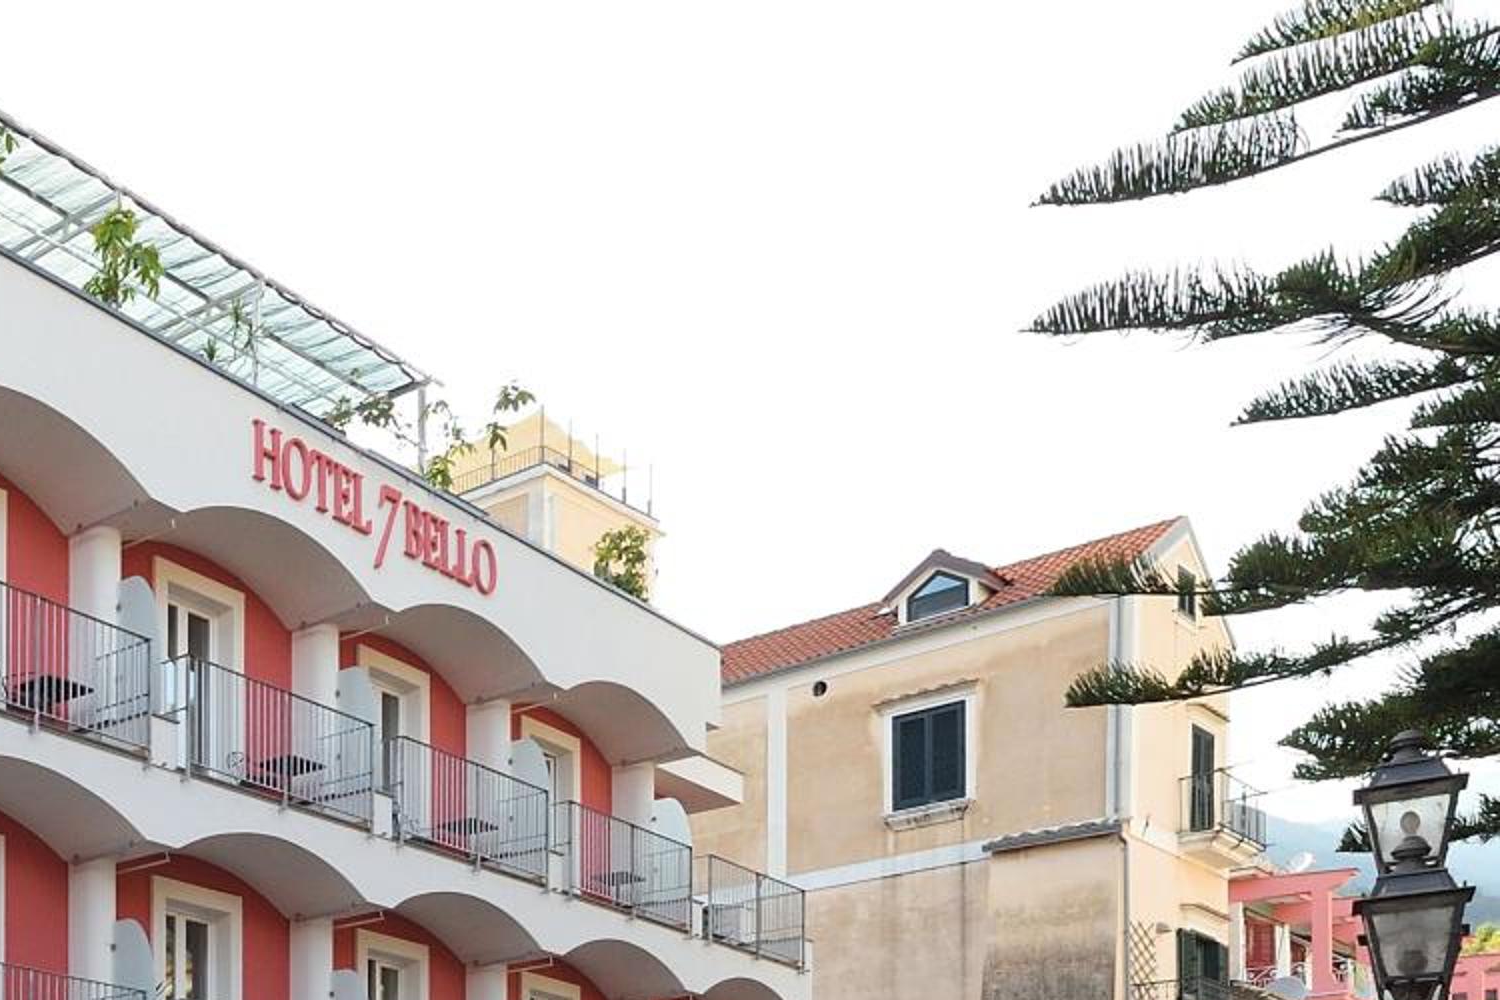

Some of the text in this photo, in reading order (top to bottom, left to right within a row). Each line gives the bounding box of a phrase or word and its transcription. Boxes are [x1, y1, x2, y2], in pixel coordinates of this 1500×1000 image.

[252, 418, 498, 597] HOTEL 7 BELLO
